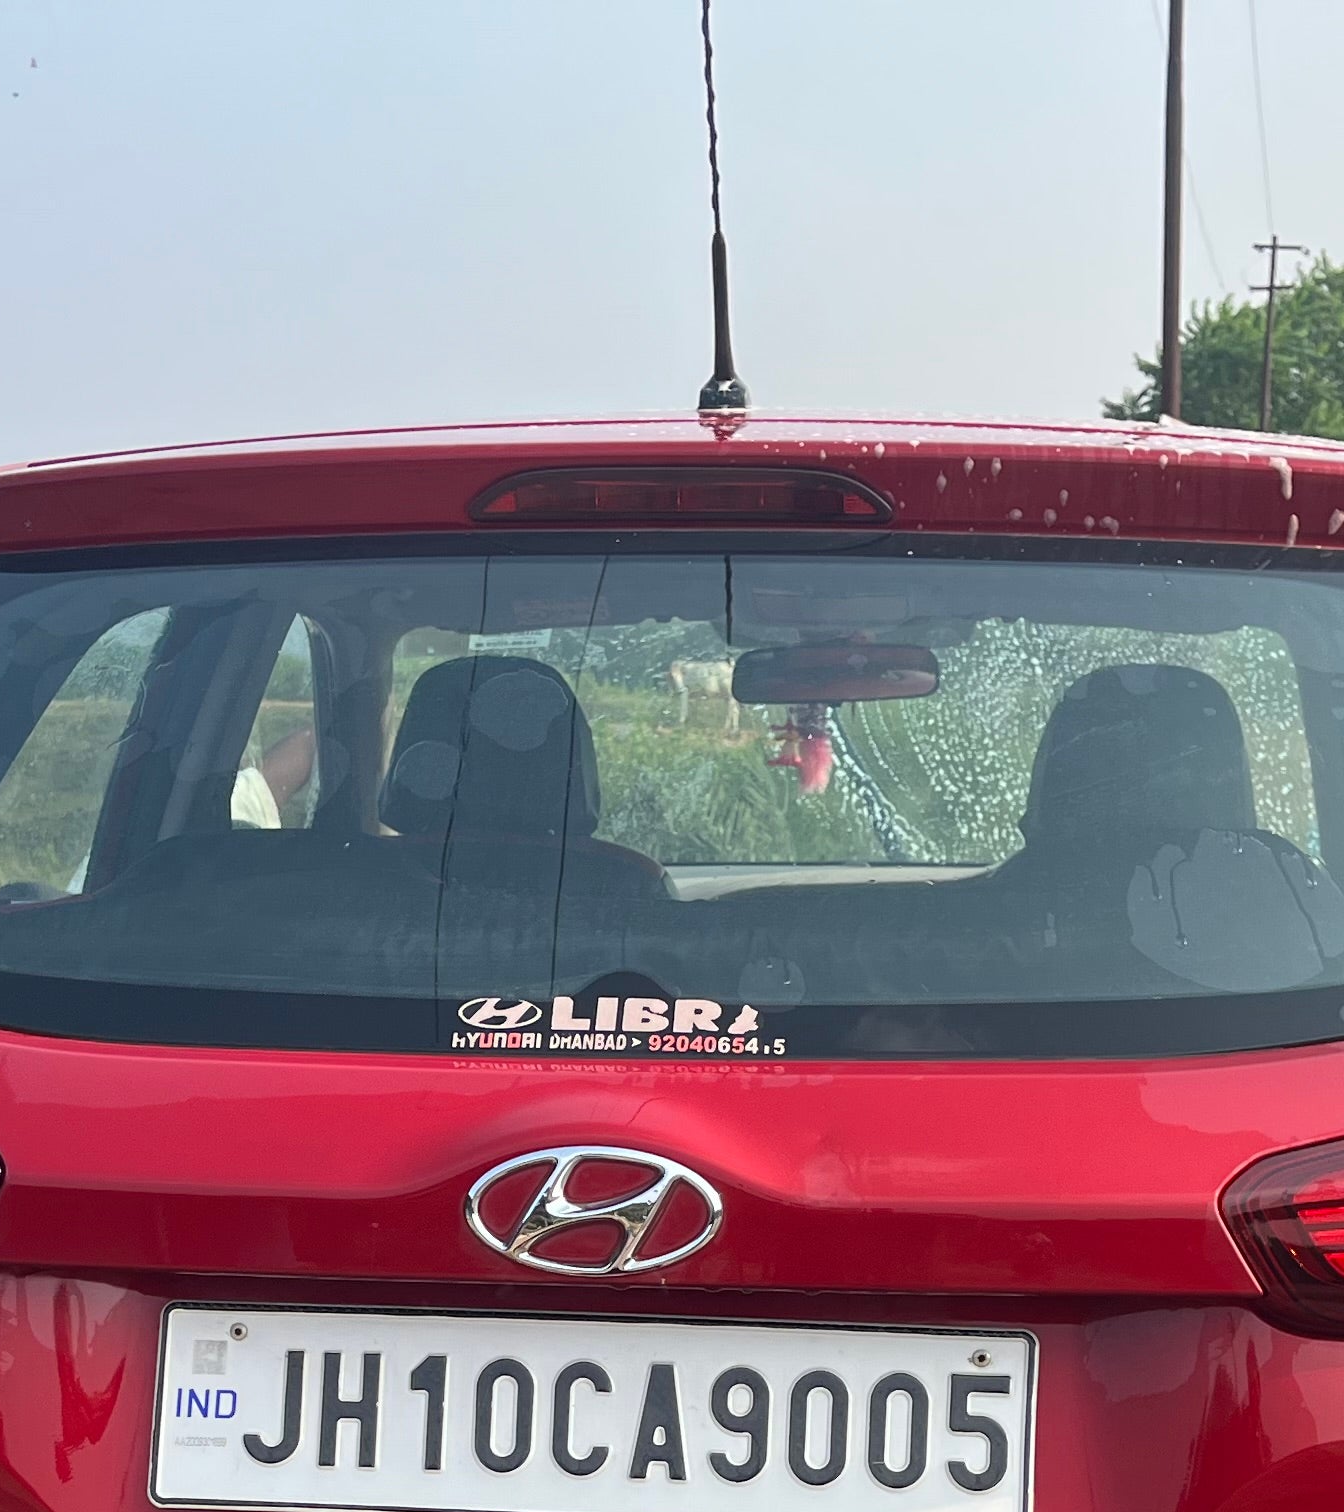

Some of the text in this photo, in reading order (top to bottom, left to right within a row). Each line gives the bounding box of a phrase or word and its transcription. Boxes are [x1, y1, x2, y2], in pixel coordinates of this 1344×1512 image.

[549, 1033, 627, 1051] DHANBAD
[648, 1034, 786, 1056] 920406545
[175, 1388, 237, 1419] IND
[242, 1349, 1012, 1492] JH10CA9005
